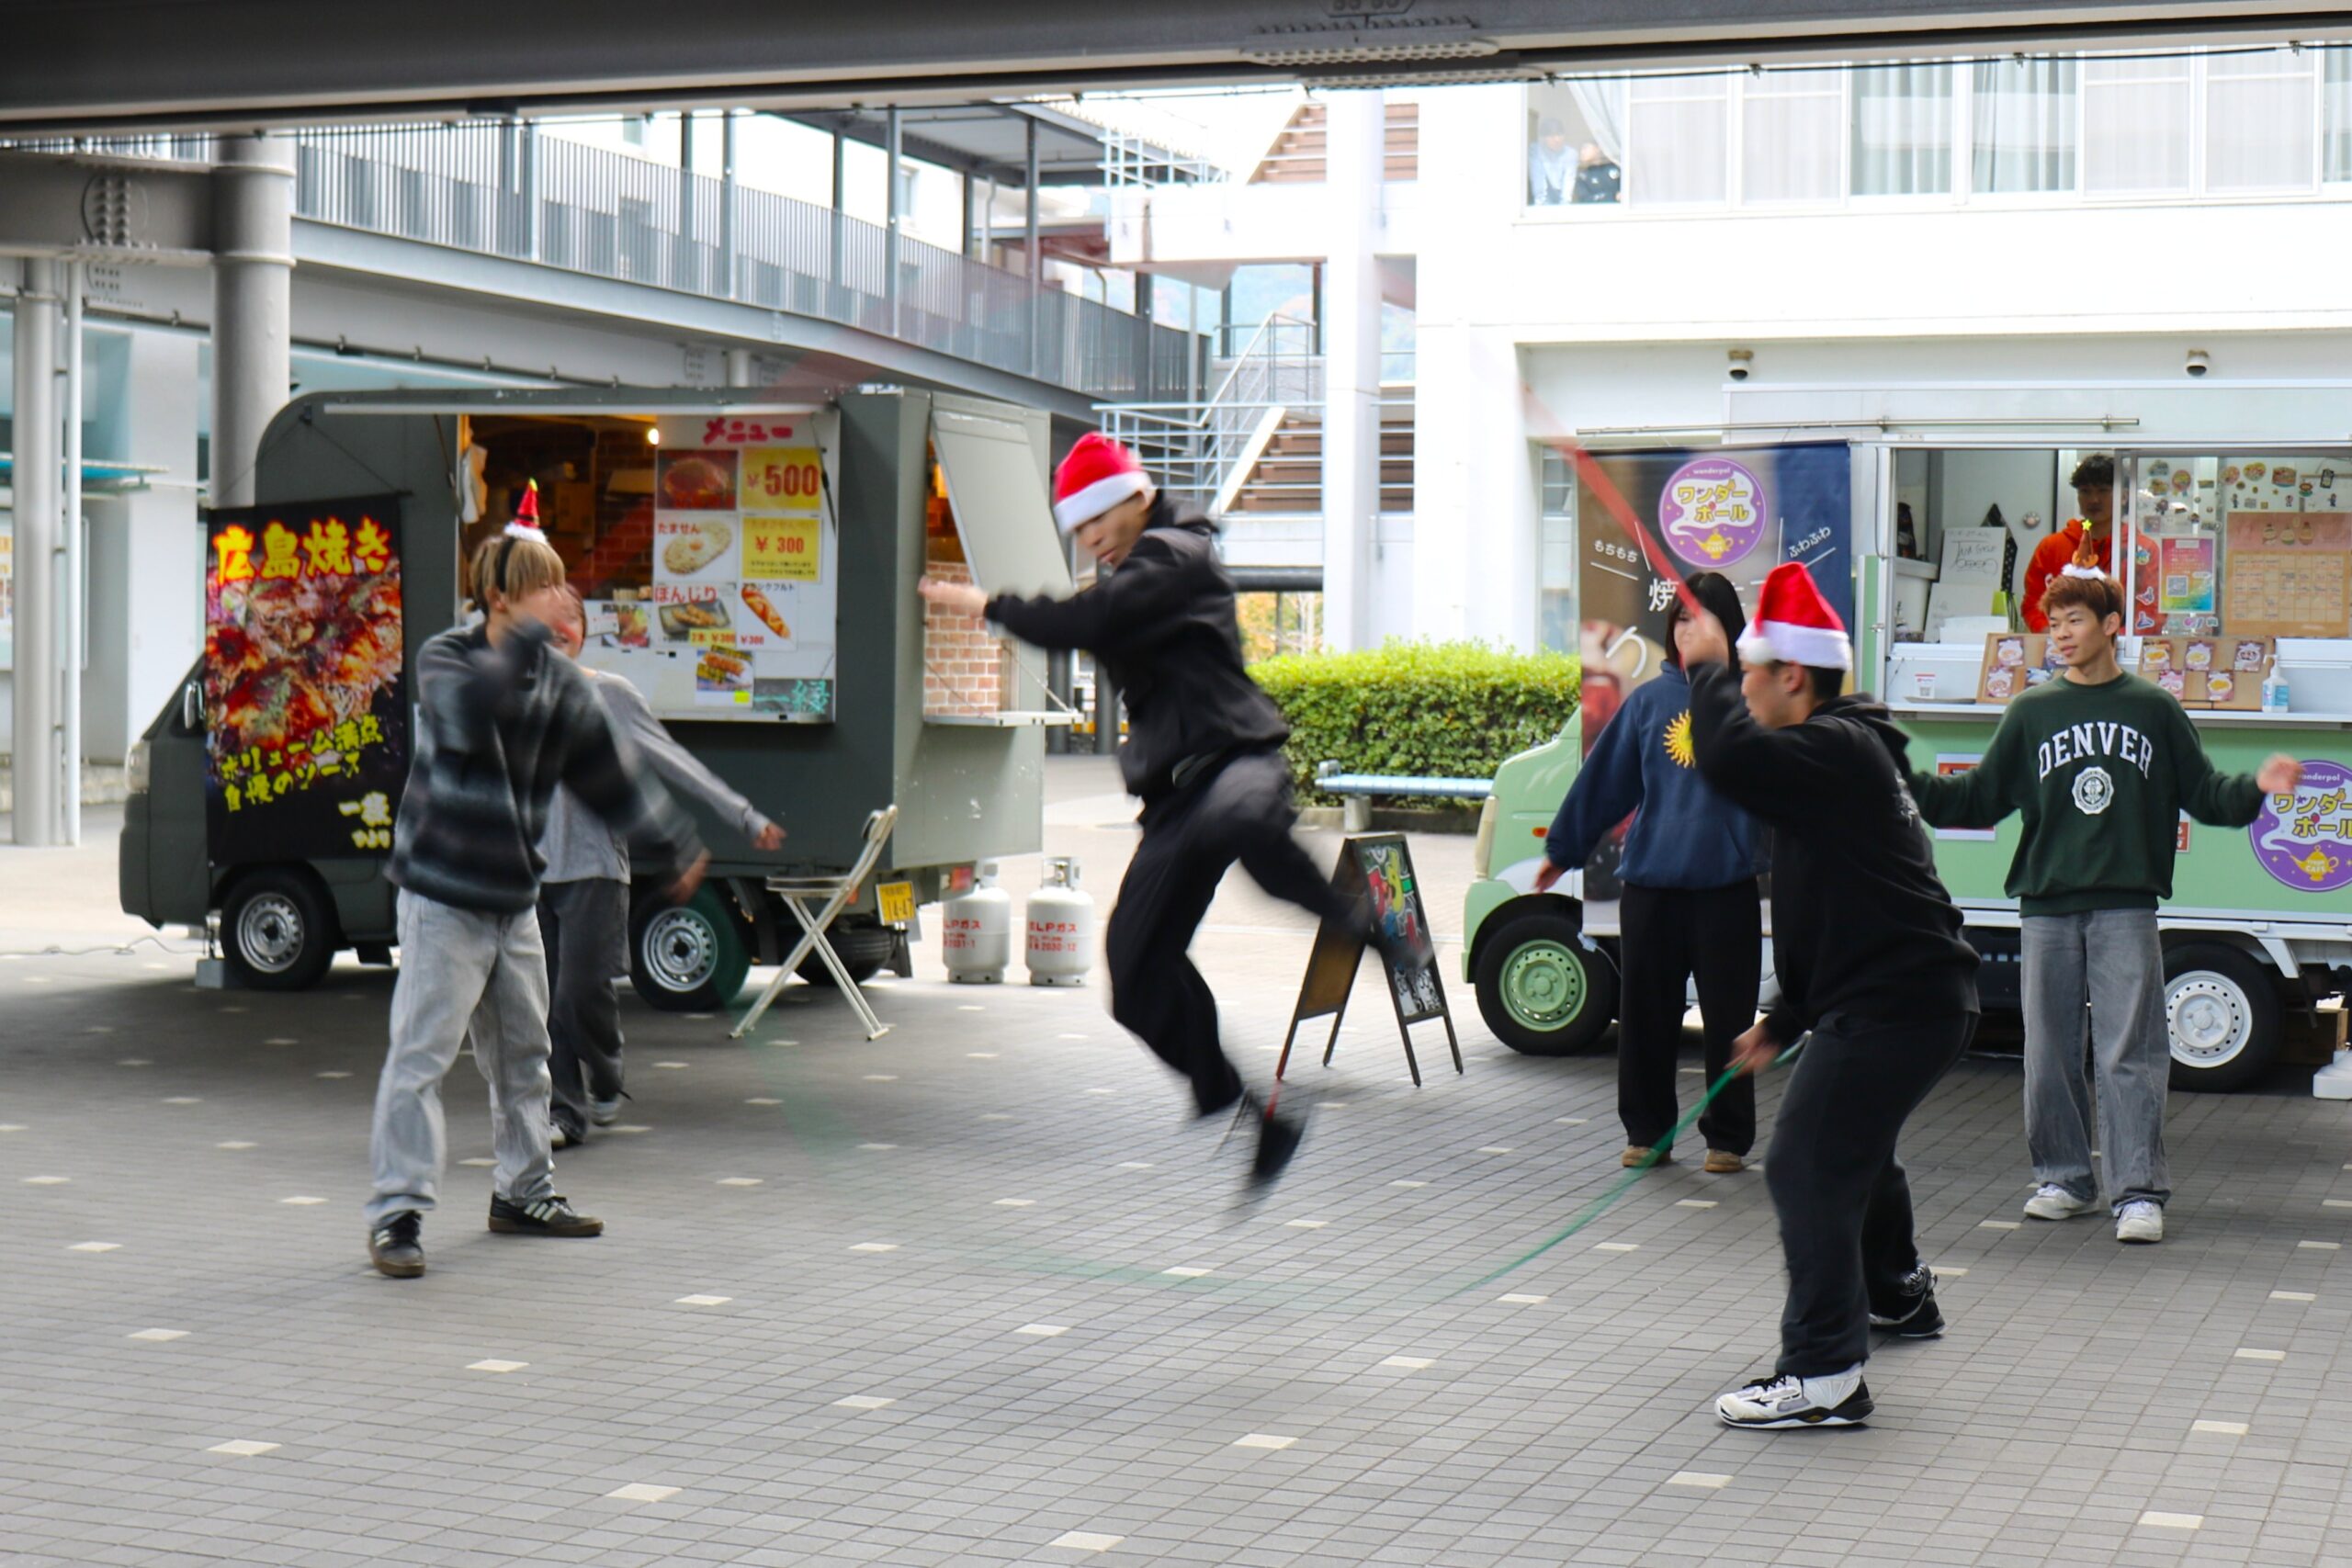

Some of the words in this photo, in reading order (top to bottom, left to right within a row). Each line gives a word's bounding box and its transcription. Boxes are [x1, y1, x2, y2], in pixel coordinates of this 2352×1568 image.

[702, 417, 793, 445] メニュー
[1678, 481, 1748, 504] ワンダー
[658, 522, 701, 535] たません
[1789, 525, 1832, 559] ふわふわ
[213, 516, 390, 584] 広島焼き
[1594, 539, 1638, 564] もちもち
[2039, 721, 2153, 784] DENVER
[225, 752, 361, 812] 自慢のソース
[2296, 773, 2340, 782] onderpol
